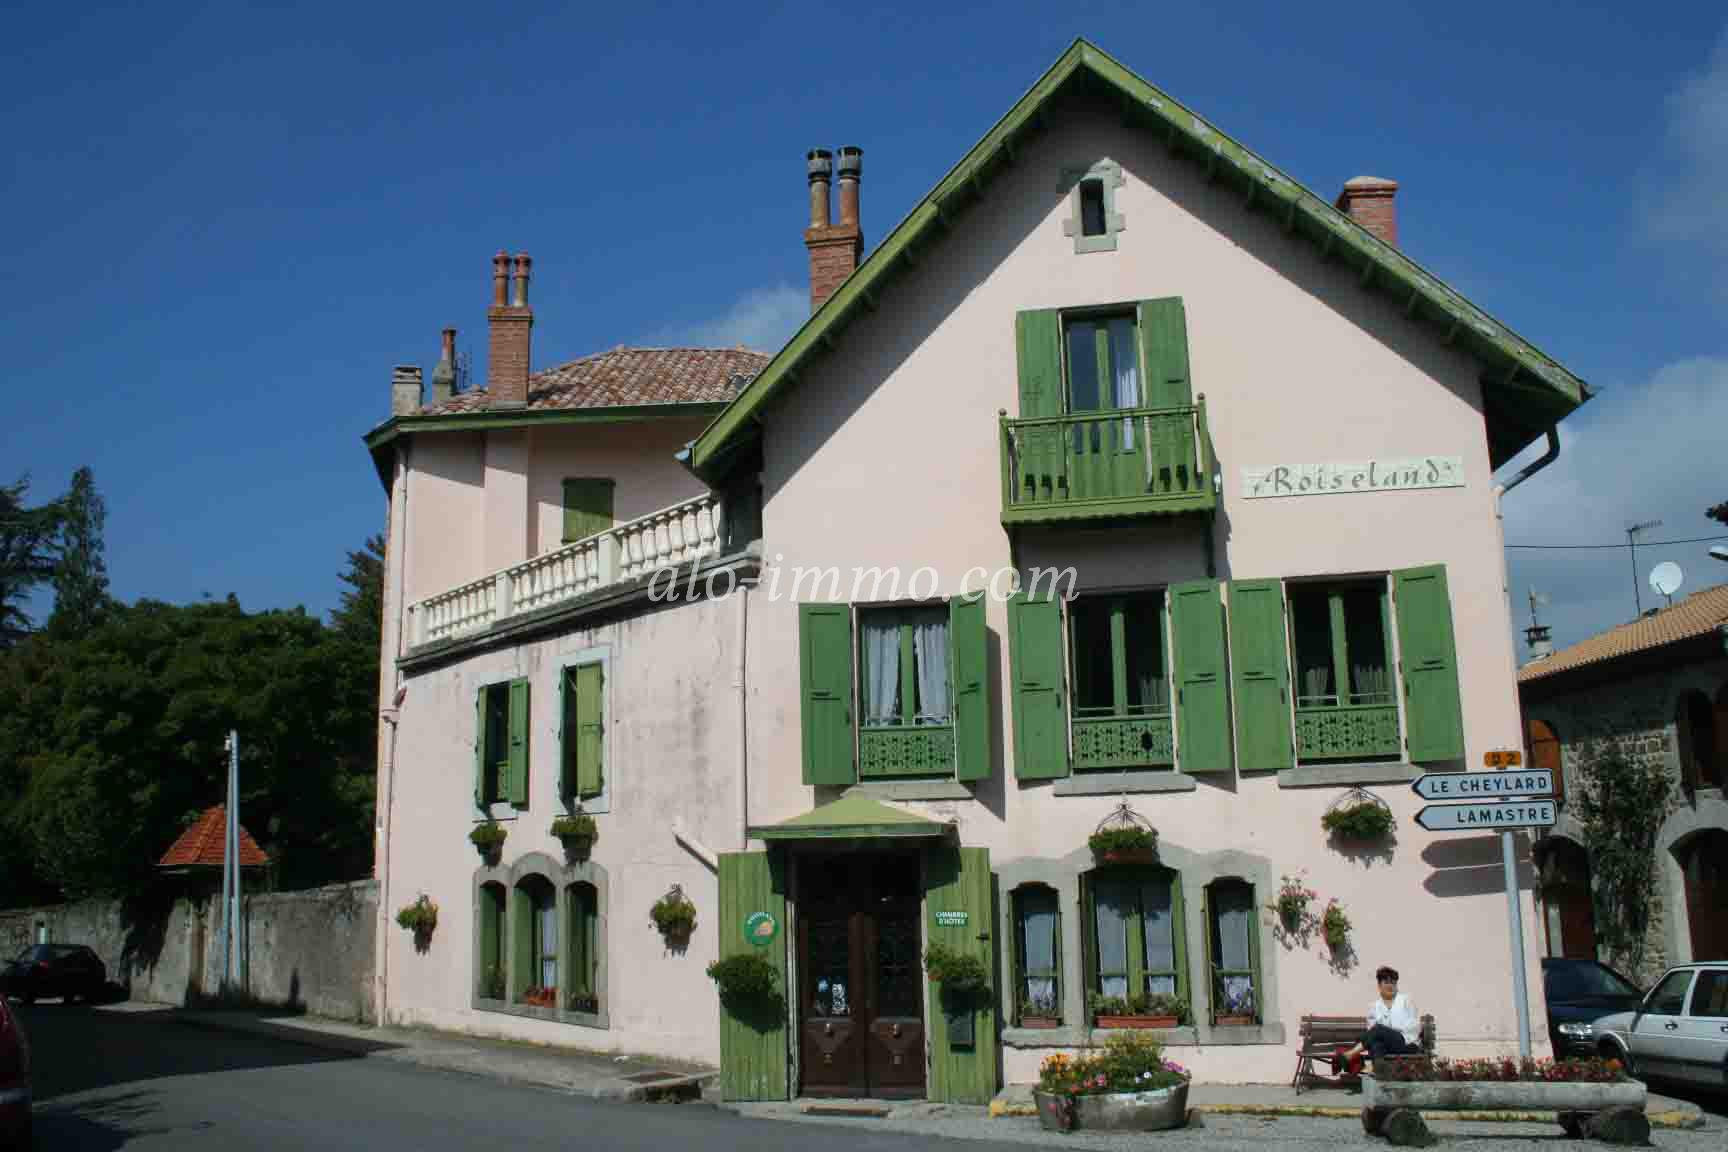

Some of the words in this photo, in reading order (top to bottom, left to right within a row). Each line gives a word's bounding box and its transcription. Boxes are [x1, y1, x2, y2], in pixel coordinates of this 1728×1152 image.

[1431, 780, 1449, 793] LE
[1459, 776, 1547, 793] CHEYLARD
[1456, 807, 1551, 823] LAMASTRE
